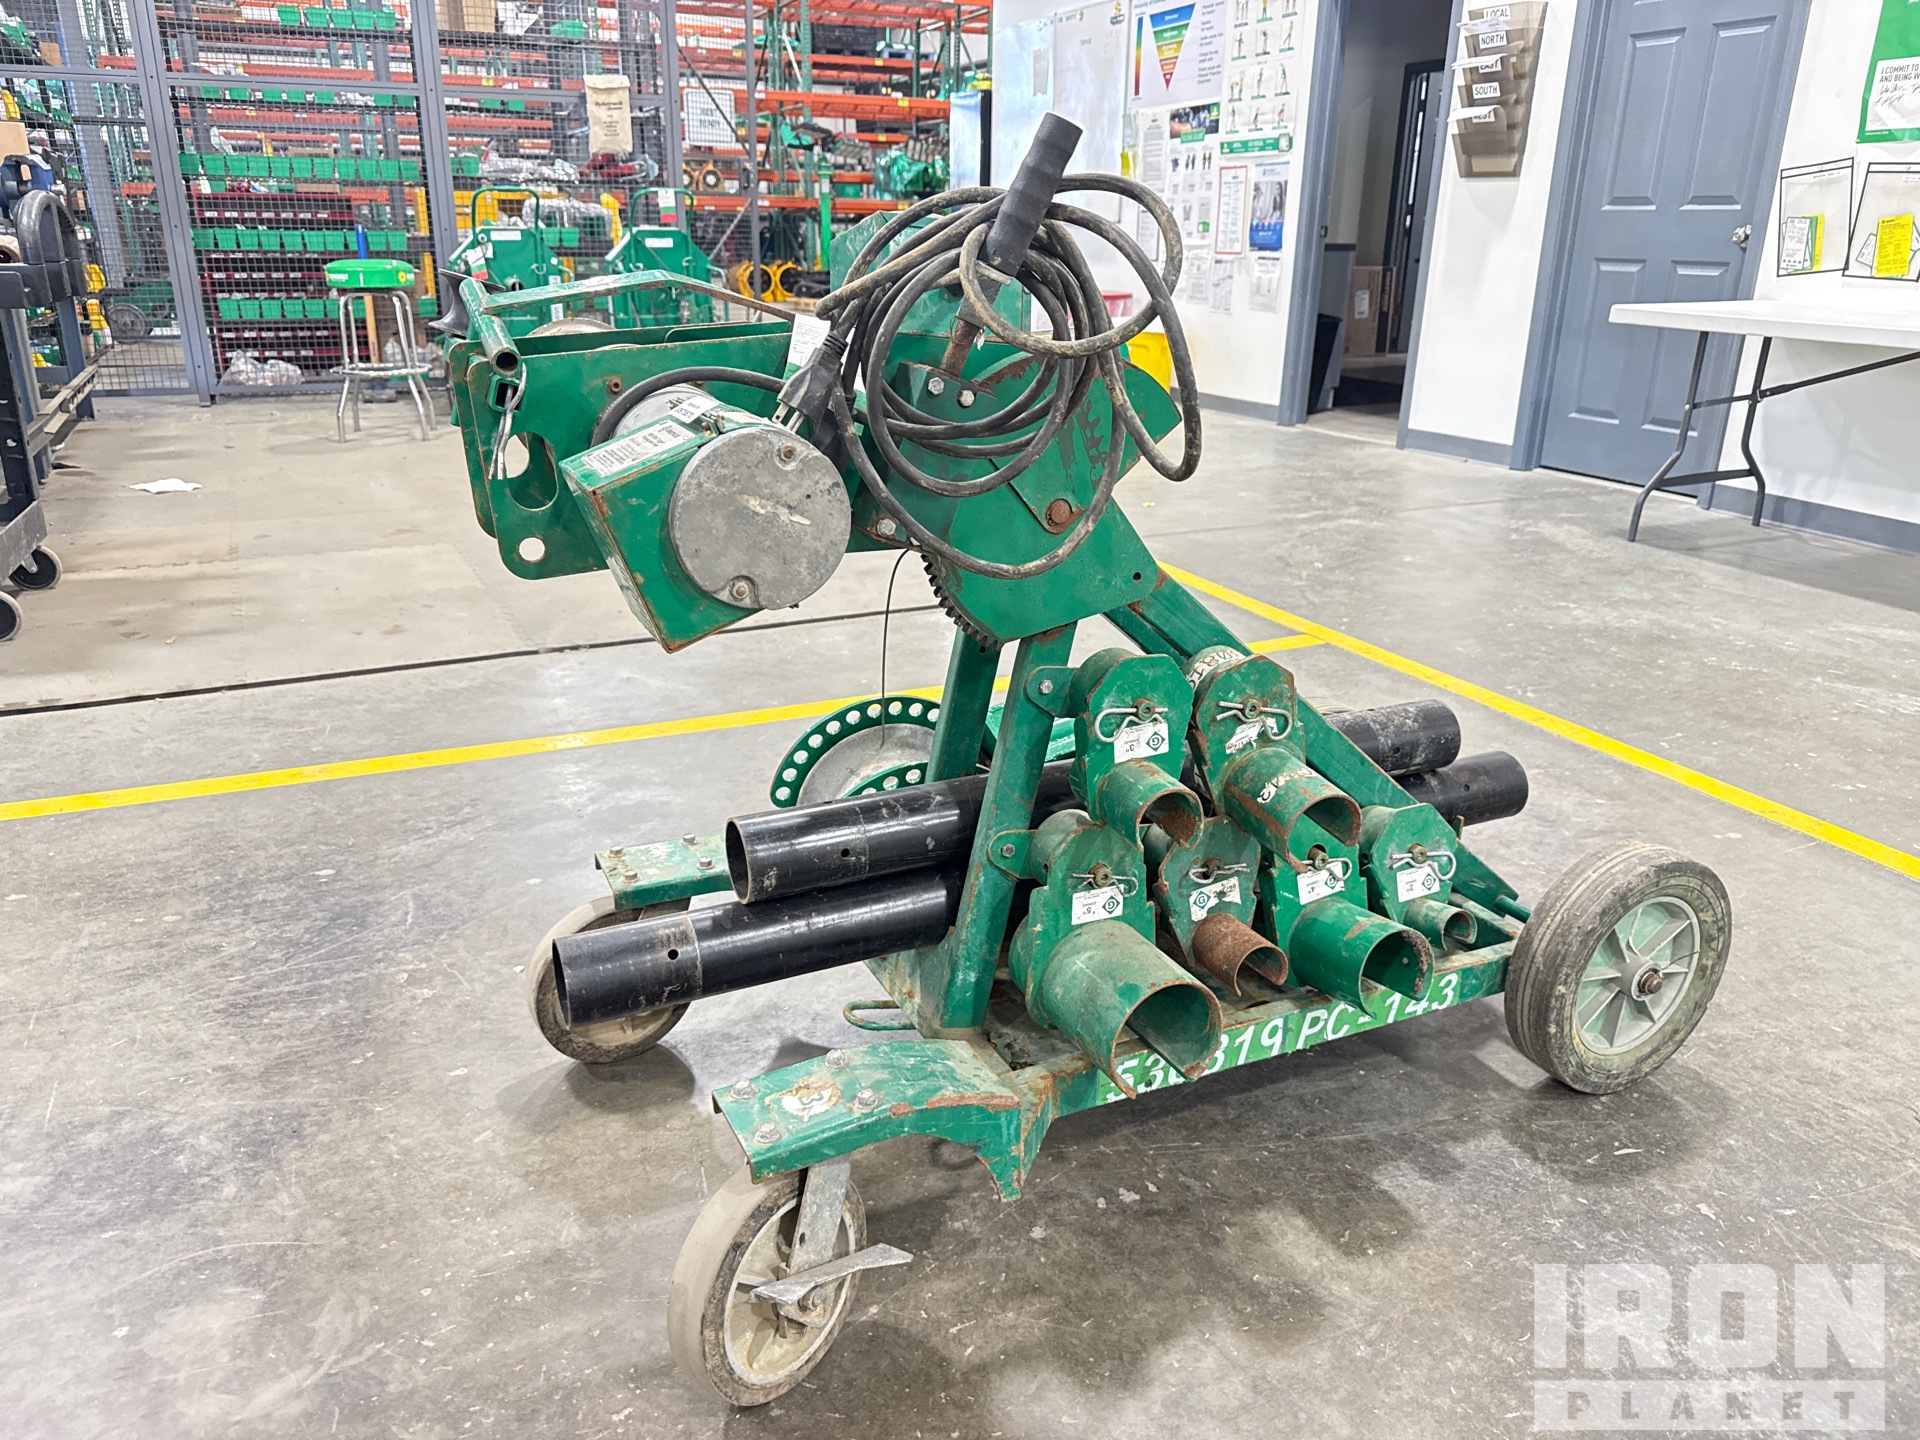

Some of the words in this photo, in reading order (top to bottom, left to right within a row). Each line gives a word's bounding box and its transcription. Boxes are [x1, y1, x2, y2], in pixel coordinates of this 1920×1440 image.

[1486, 8, 1509, 18] LOCAL
[1481, 34, 1505, 45] NORTH
[1885, 64, 1910, 75] COMMIT
[1911, 63, 1920, 72] TO
[1879, 75, 1893, 83] AND
[1894, 72, 1912, 82] BEING
[1475, 85, 1498, 96] SOUTH
